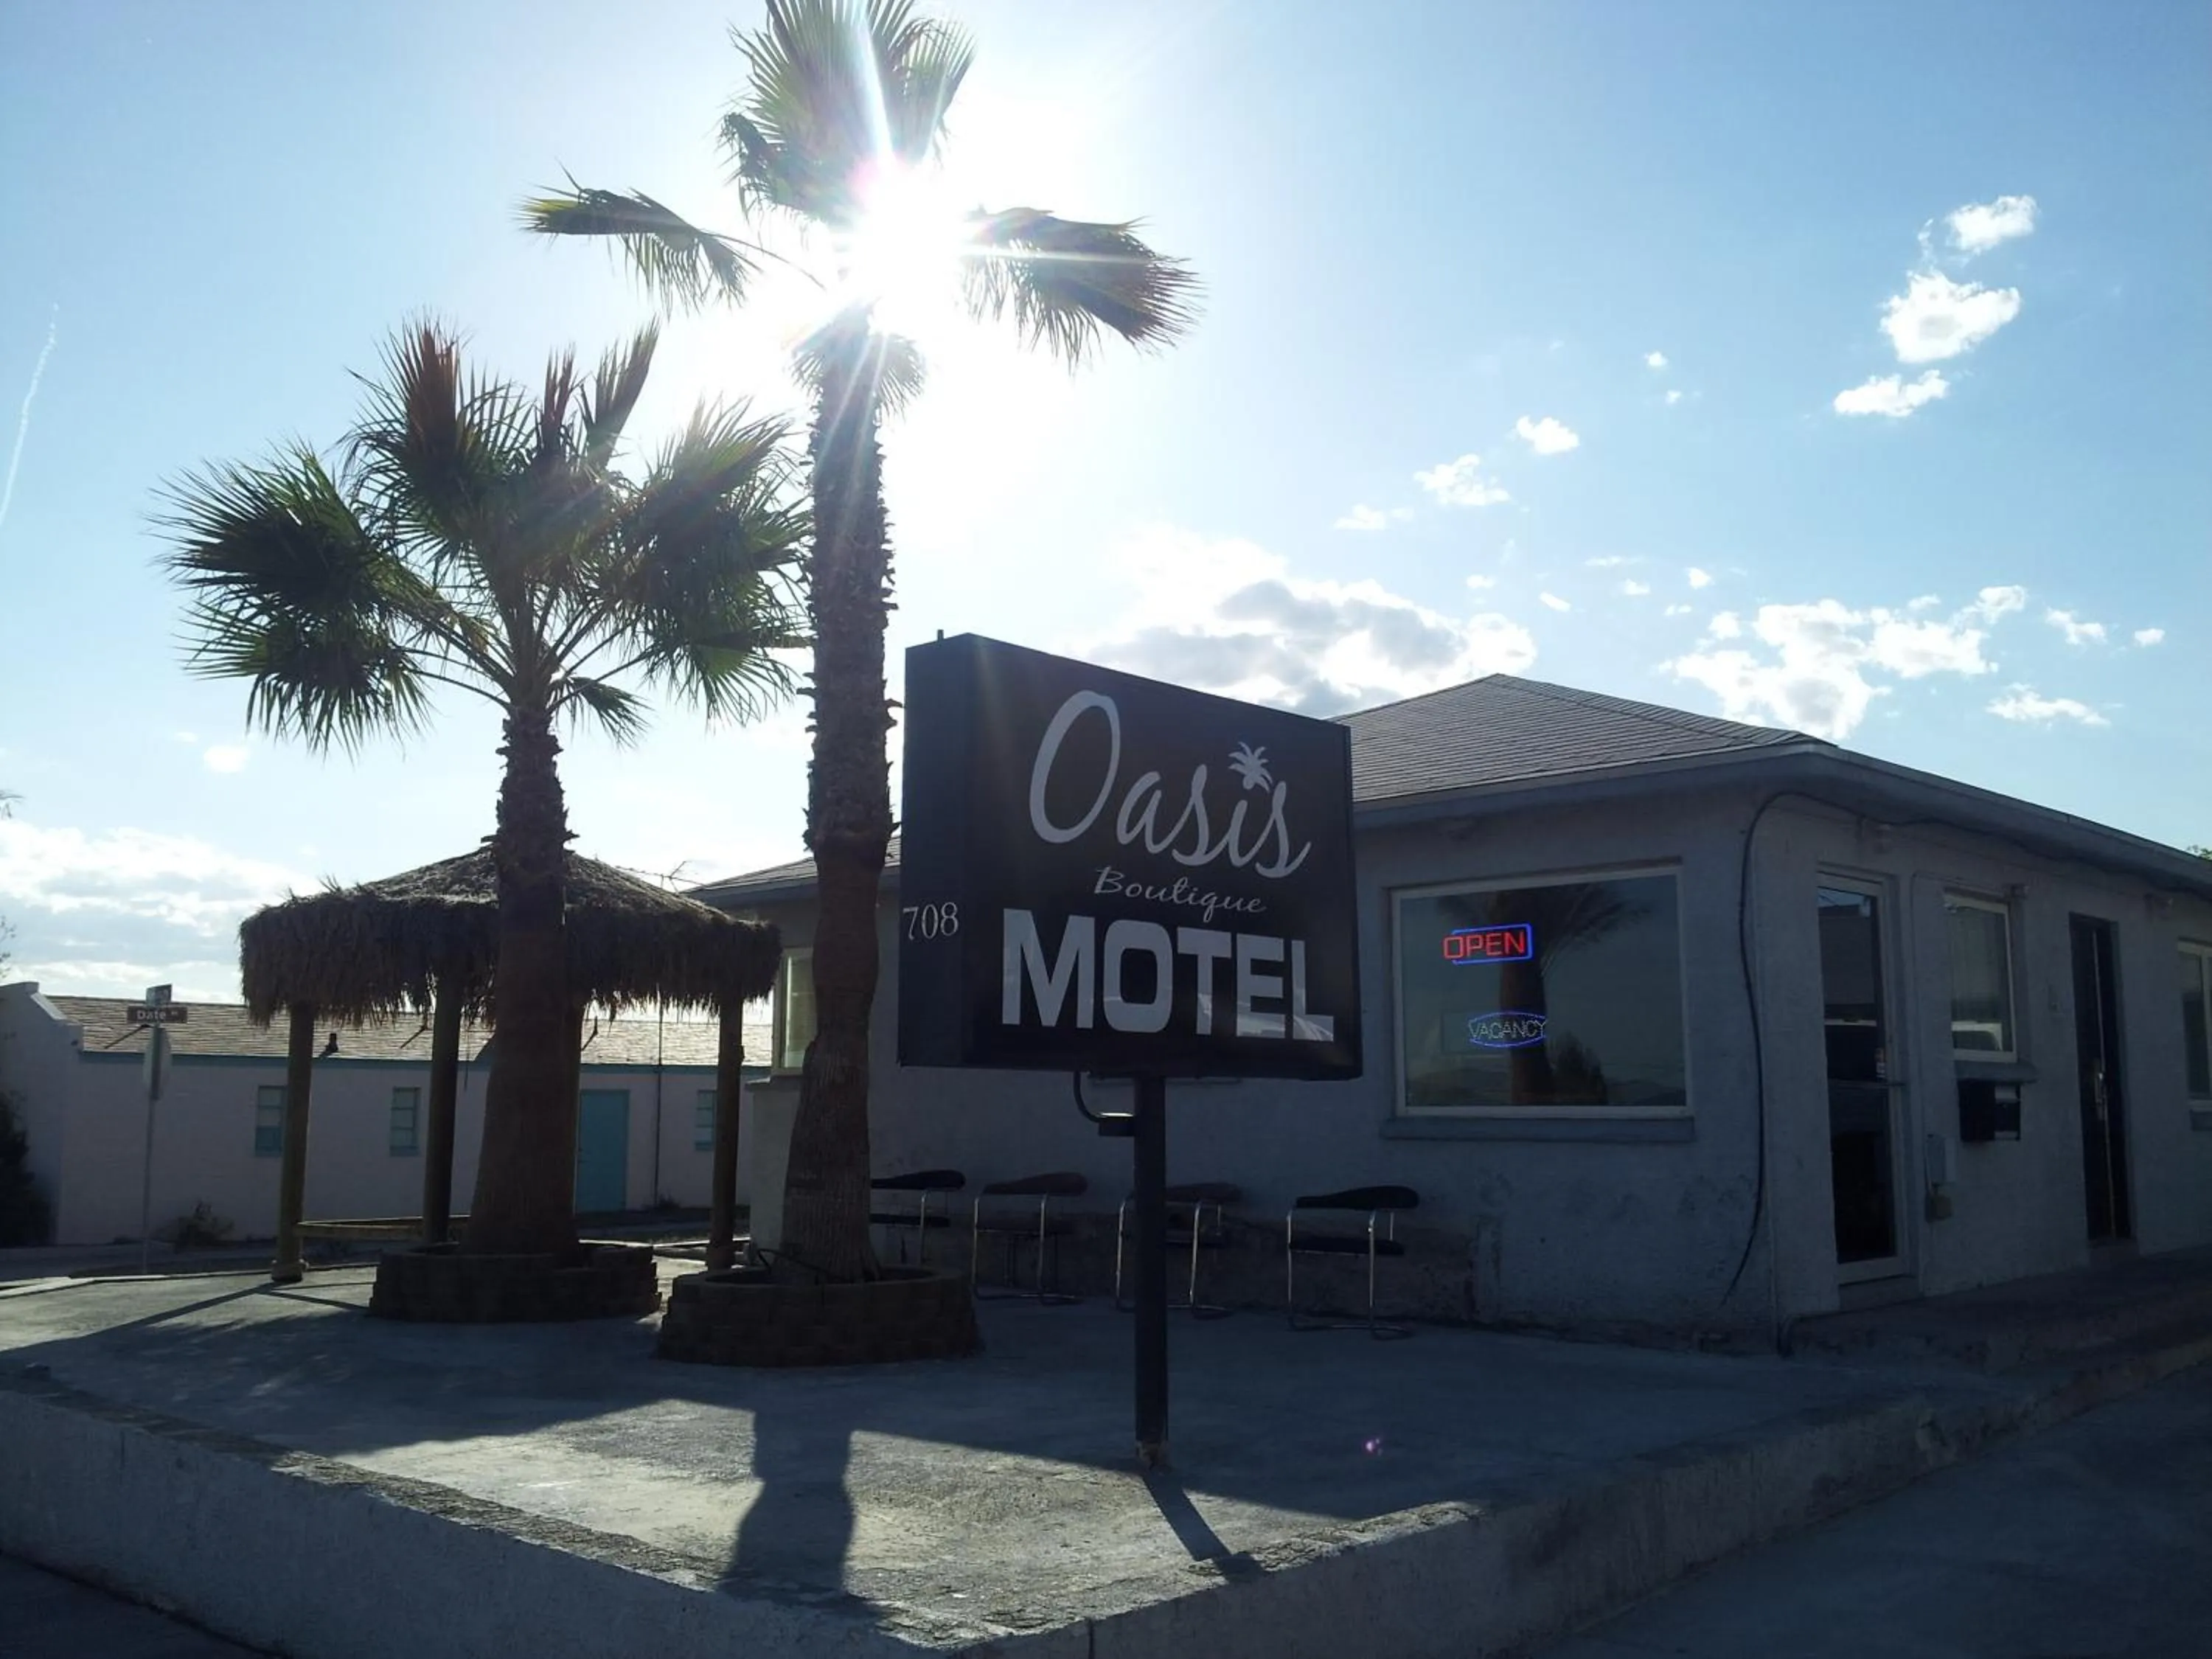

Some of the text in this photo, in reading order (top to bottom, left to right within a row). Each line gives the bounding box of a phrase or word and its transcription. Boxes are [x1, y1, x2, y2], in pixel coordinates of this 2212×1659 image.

[1029, 689, 1312, 879] Oasis
[1093, 866, 1267, 924] Boutique
[902, 902, 959, 941] 708
[1442, 930, 1526, 960] OPEN
[1001, 908, 1335, 1043] MOTEL
[1467, 1019, 1547, 1040] VACANCY
